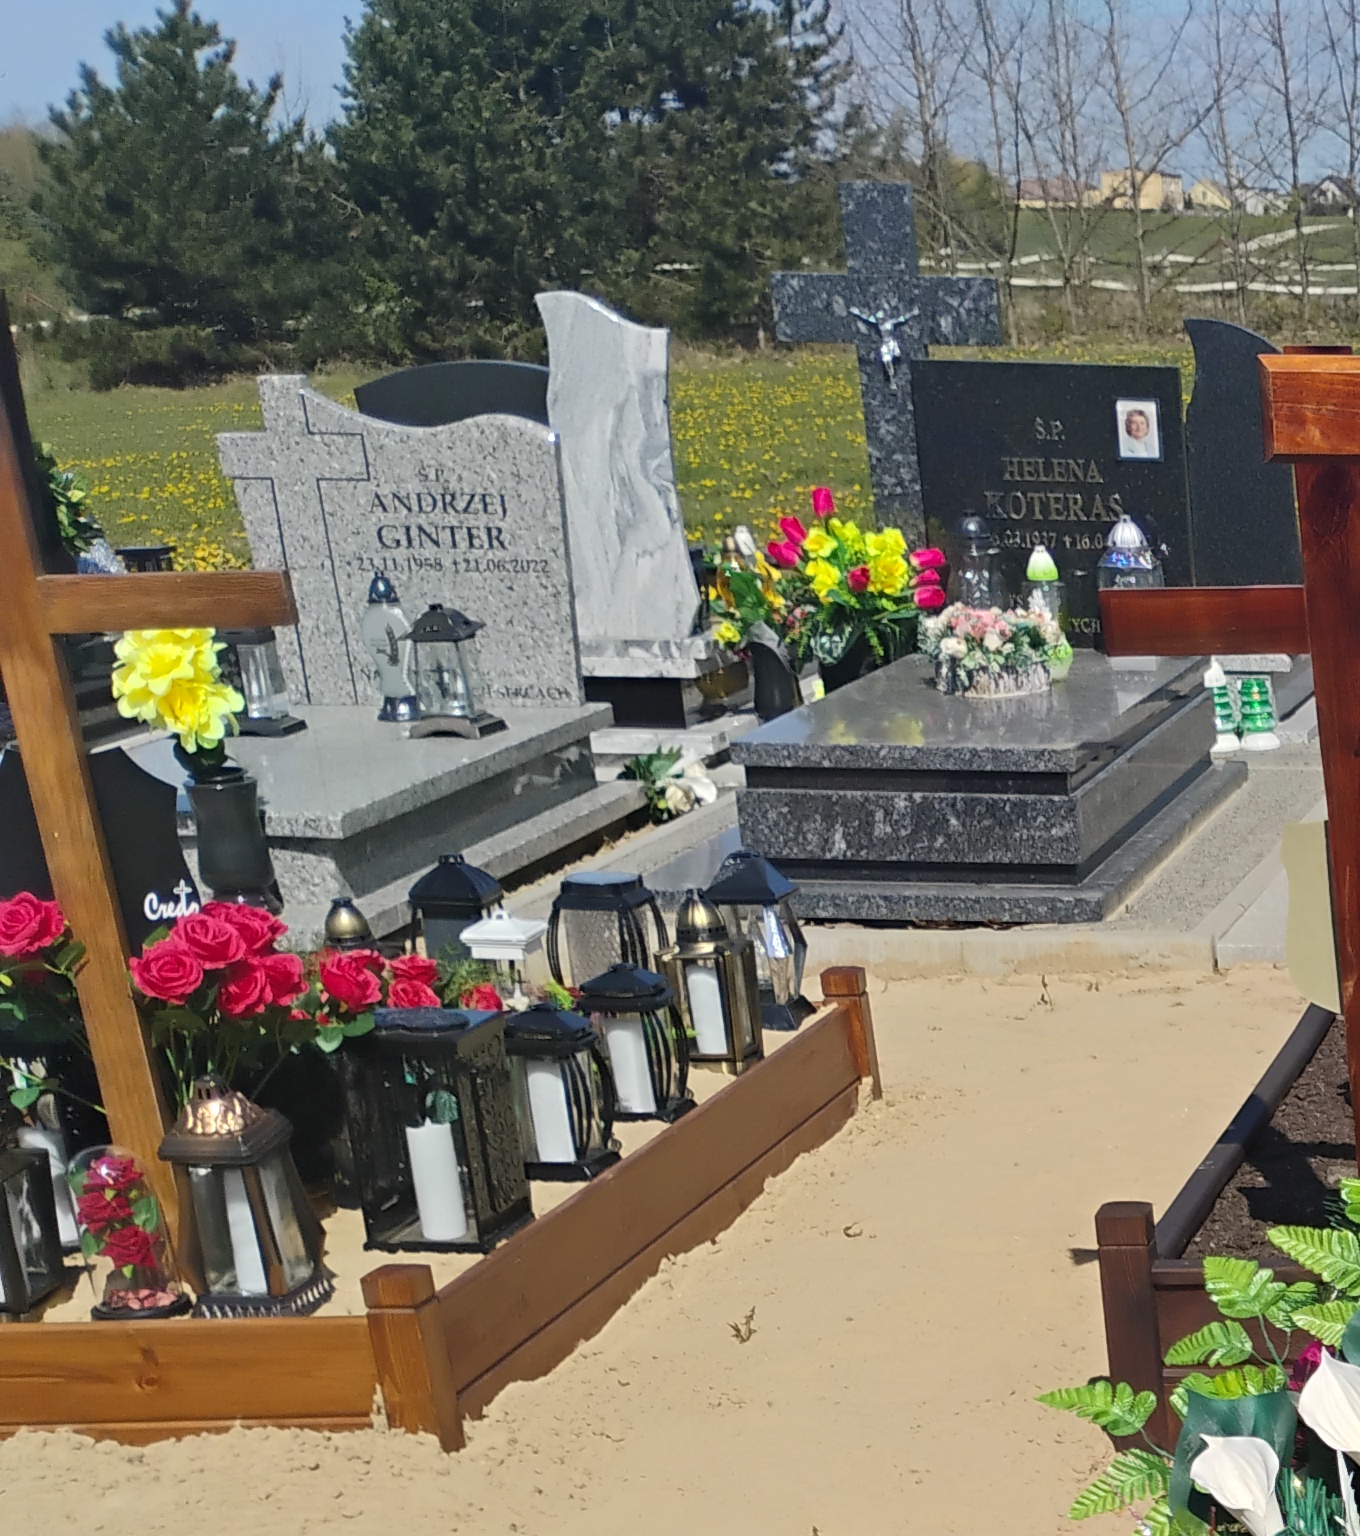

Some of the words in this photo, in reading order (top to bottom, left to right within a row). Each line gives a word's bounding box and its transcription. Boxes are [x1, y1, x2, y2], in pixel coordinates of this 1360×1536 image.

[1001, 457, 1105, 484] HELENA
[369, 491, 508, 519] ANDRZEJ
[983, 491, 1126, 522] KOTERAS
[376, 524, 509, 551] GINTER
